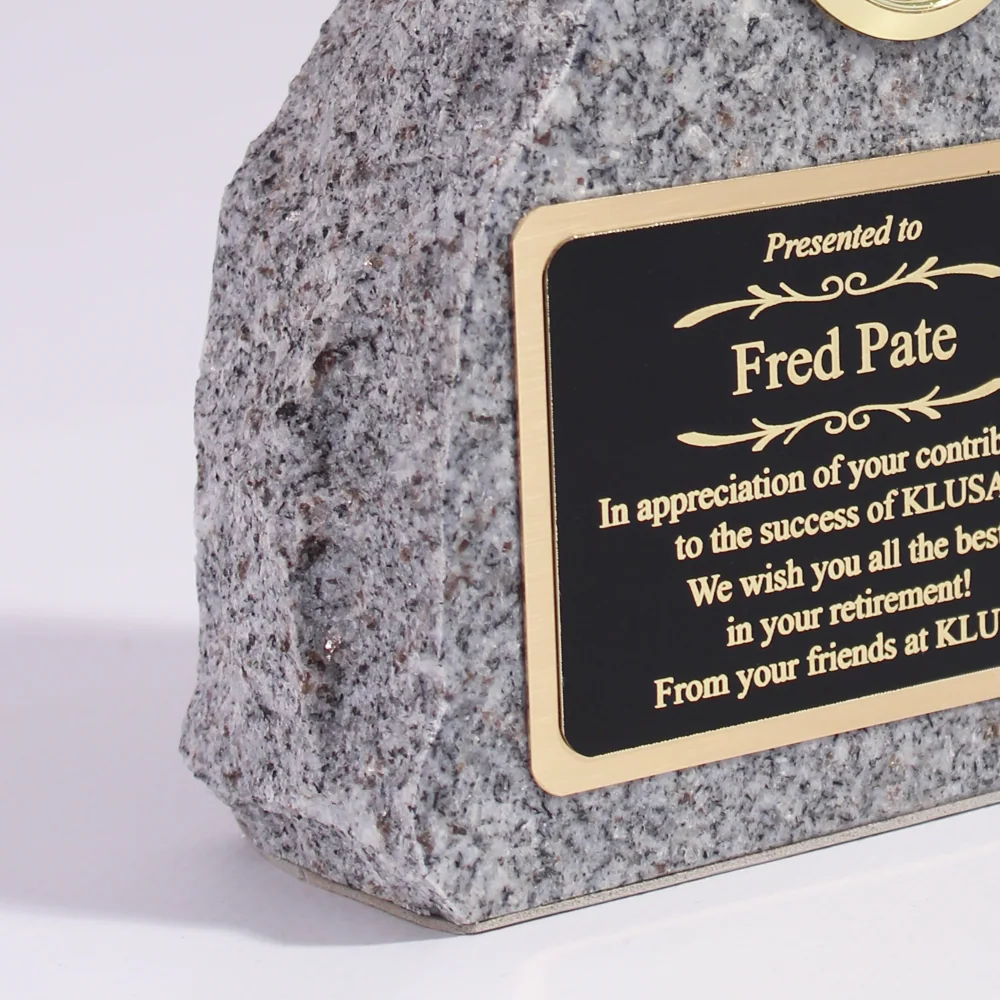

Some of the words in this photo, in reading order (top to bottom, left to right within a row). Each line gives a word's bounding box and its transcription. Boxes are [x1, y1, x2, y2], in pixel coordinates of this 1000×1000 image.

[763, 215, 893, 262] Presented
[898, 218, 922, 243] to
[731, 326, 844, 395] Fred
[856, 319, 956, 374] Pate
[599, 498, 630, 528] In
[637, 467, 806, 527] appreciation
[813, 455, 844, 488] of
[847, 451, 909, 490] your
[675, 536, 703, 560] to
[710, 522, 752, 553] the
[760, 506, 860, 544] success
[867, 489, 899, 523] of
[687, 574, 732, 607] We
[739, 559, 804, 597] wish
[811, 555, 862, 592] you
[869, 538, 901, 572] all
[908, 533, 948, 563] the
[727, 616, 754, 646] in
[760, 607, 823, 647] your
[829, 569, 970, 625] retirement!
[654, 674, 730, 708] From
[736, 659, 799, 699] your
[806, 632, 897, 676] friends
[905, 628, 928, 655] at
